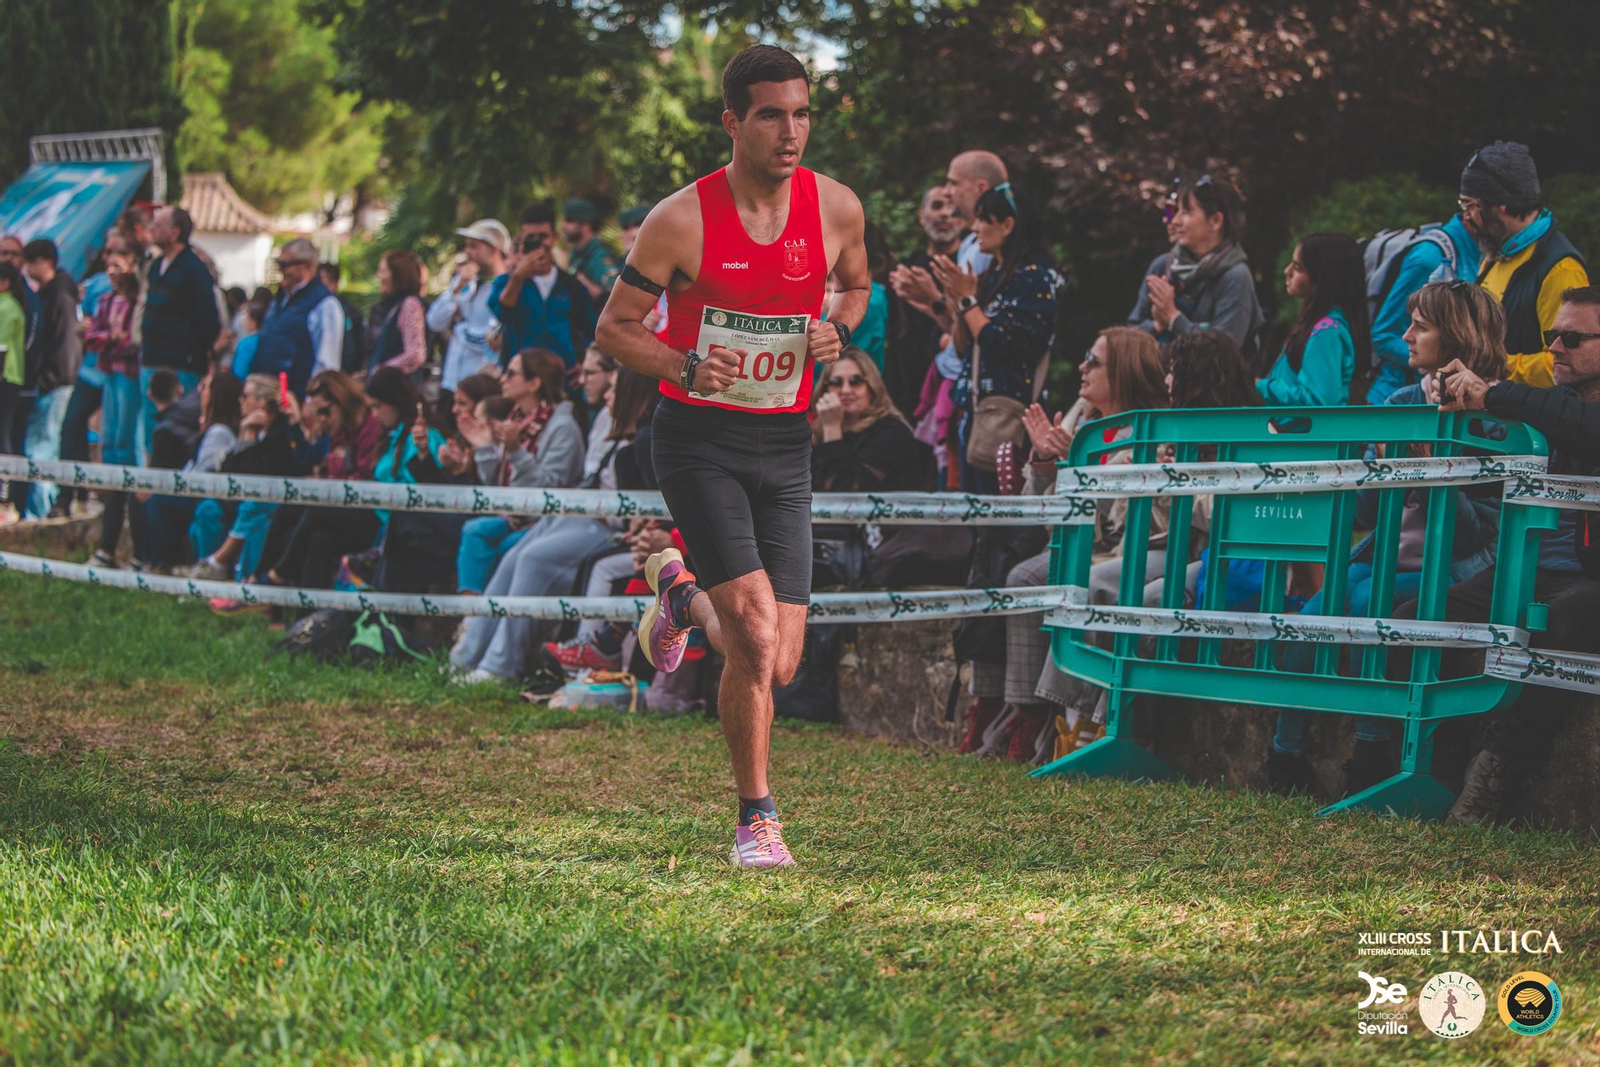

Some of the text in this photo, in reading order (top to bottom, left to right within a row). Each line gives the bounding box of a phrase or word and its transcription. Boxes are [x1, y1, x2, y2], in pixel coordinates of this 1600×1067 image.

[722, 261, 749, 270] mobel
[734, 316, 782, 332] ITÁLICA
[708, 344, 796, 383] 109
[1189, 477, 1221, 488] Sevilla
[1287, 472, 1320, 485] Sevilla
[1391, 470, 1427, 481] Sevilla
[1545, 487, 1586, 501] Sevilla
[1254, 505, 1303, 519] SEVILLA
[1557, 668, 1595, 685] Sevilla
